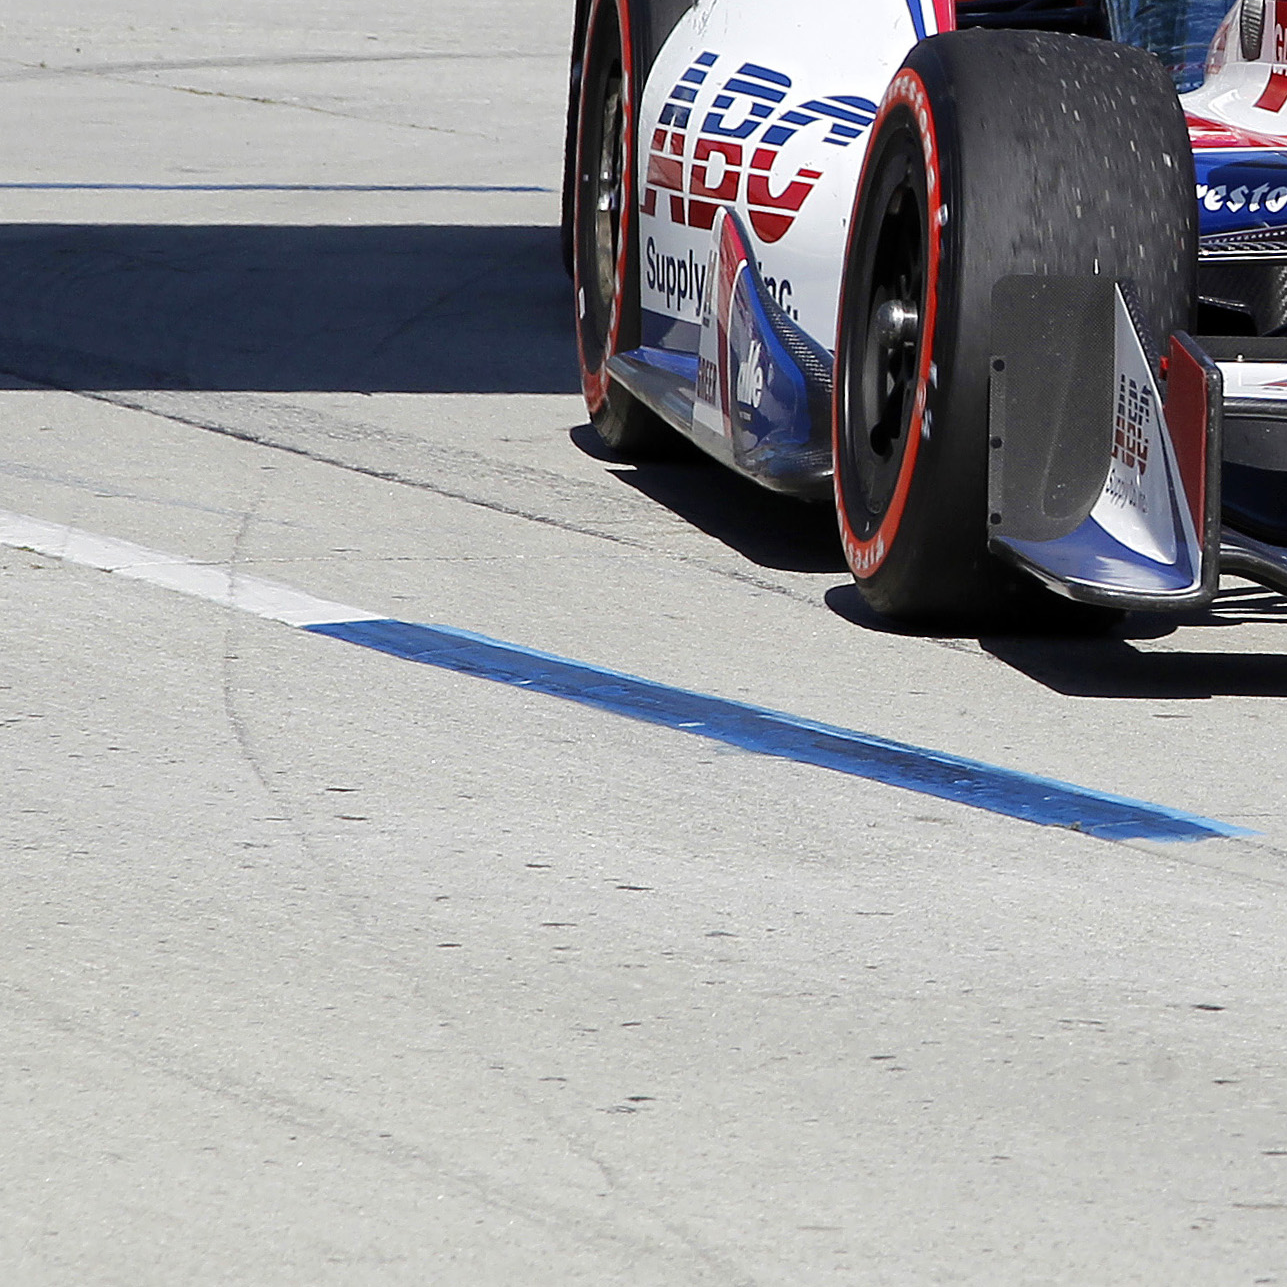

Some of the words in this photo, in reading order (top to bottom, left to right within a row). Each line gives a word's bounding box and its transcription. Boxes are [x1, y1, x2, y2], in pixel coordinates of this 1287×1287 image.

[639, 51, 879, 244] ABC
[645, 236, 706, 318] Supply
[756, 261, 799, 321] nc.
